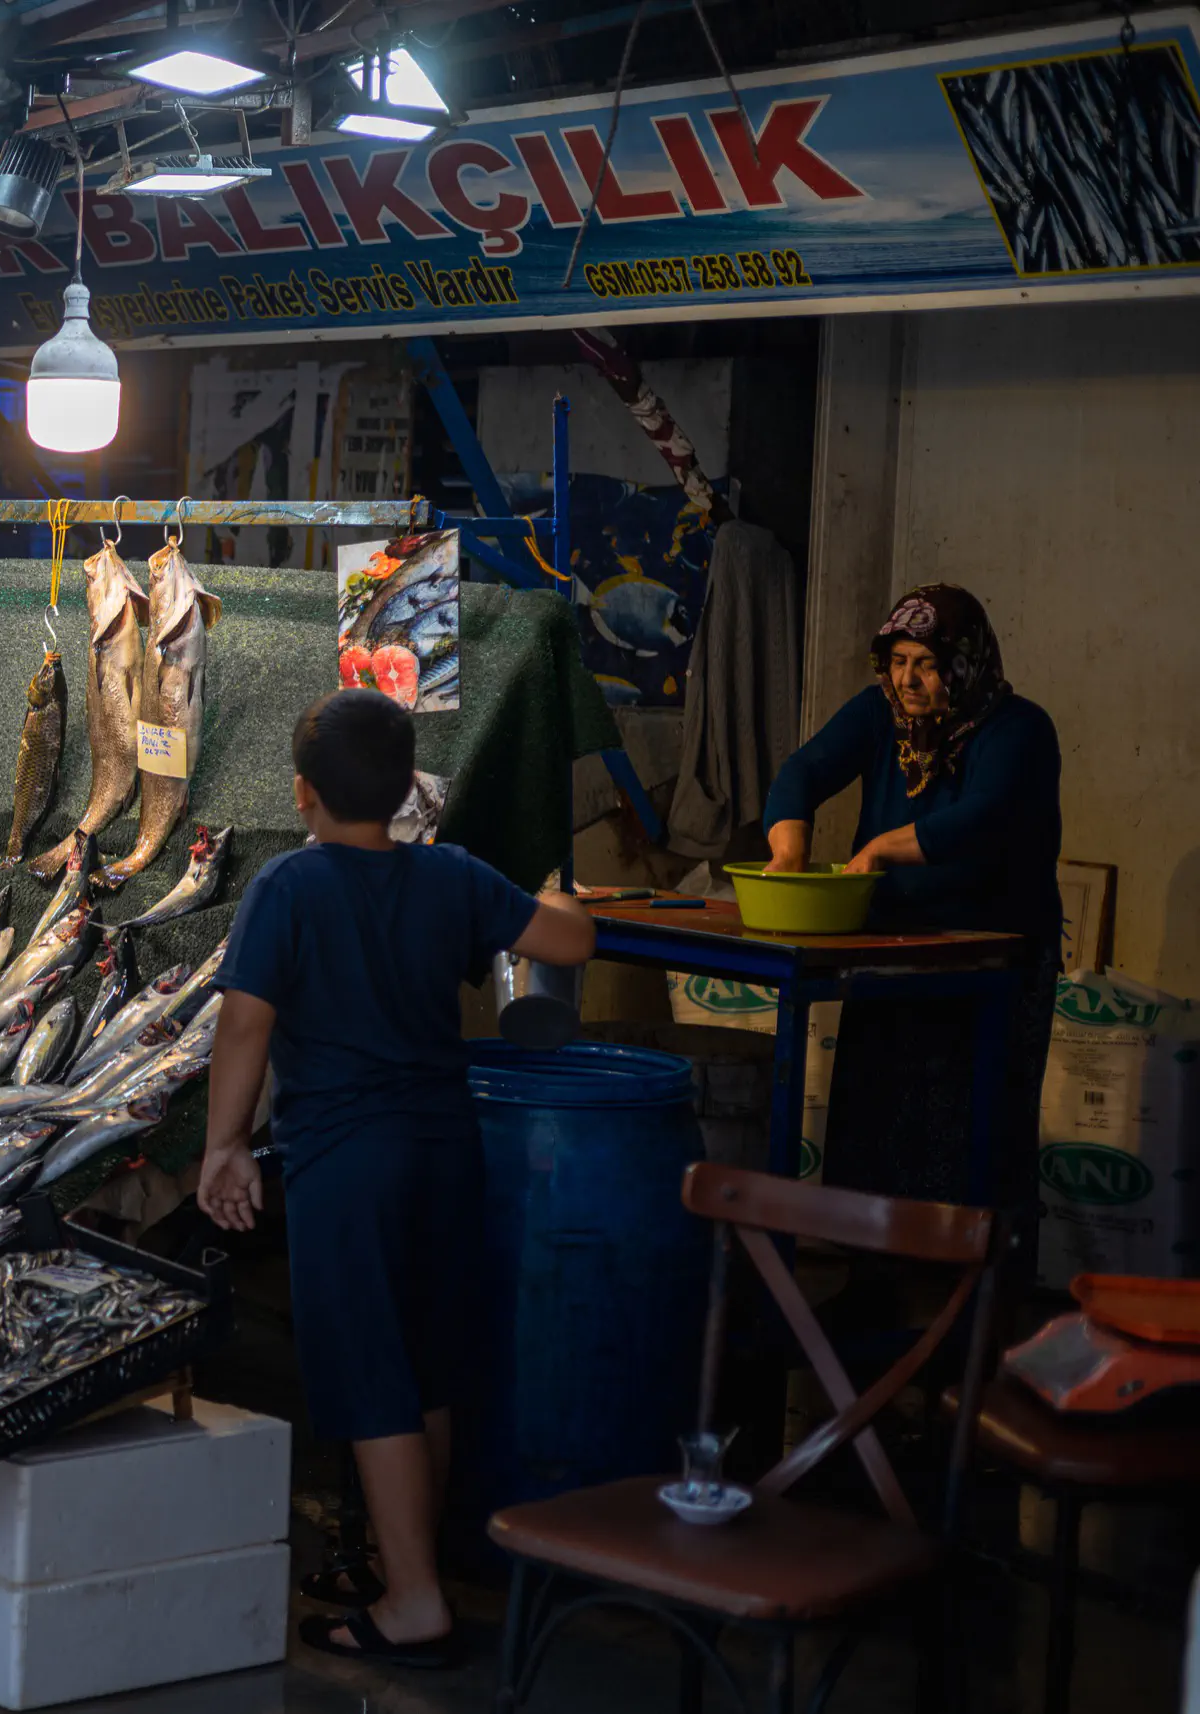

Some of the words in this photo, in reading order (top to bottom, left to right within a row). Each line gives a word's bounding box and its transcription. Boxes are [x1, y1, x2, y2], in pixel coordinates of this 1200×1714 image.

[62, 94, 869, 268] BALIKÇILIK
[220, 269, 316, 320] Paket
[308, 264, 416, 315] Servis
[405, 256, 519, 307] Vardır
[691, 253, 741, 291] 258
[736, 250, 777, 289] 58
[772, 248, 813, 286] 92
[1049, 1152, 1134, 1197] ANI
